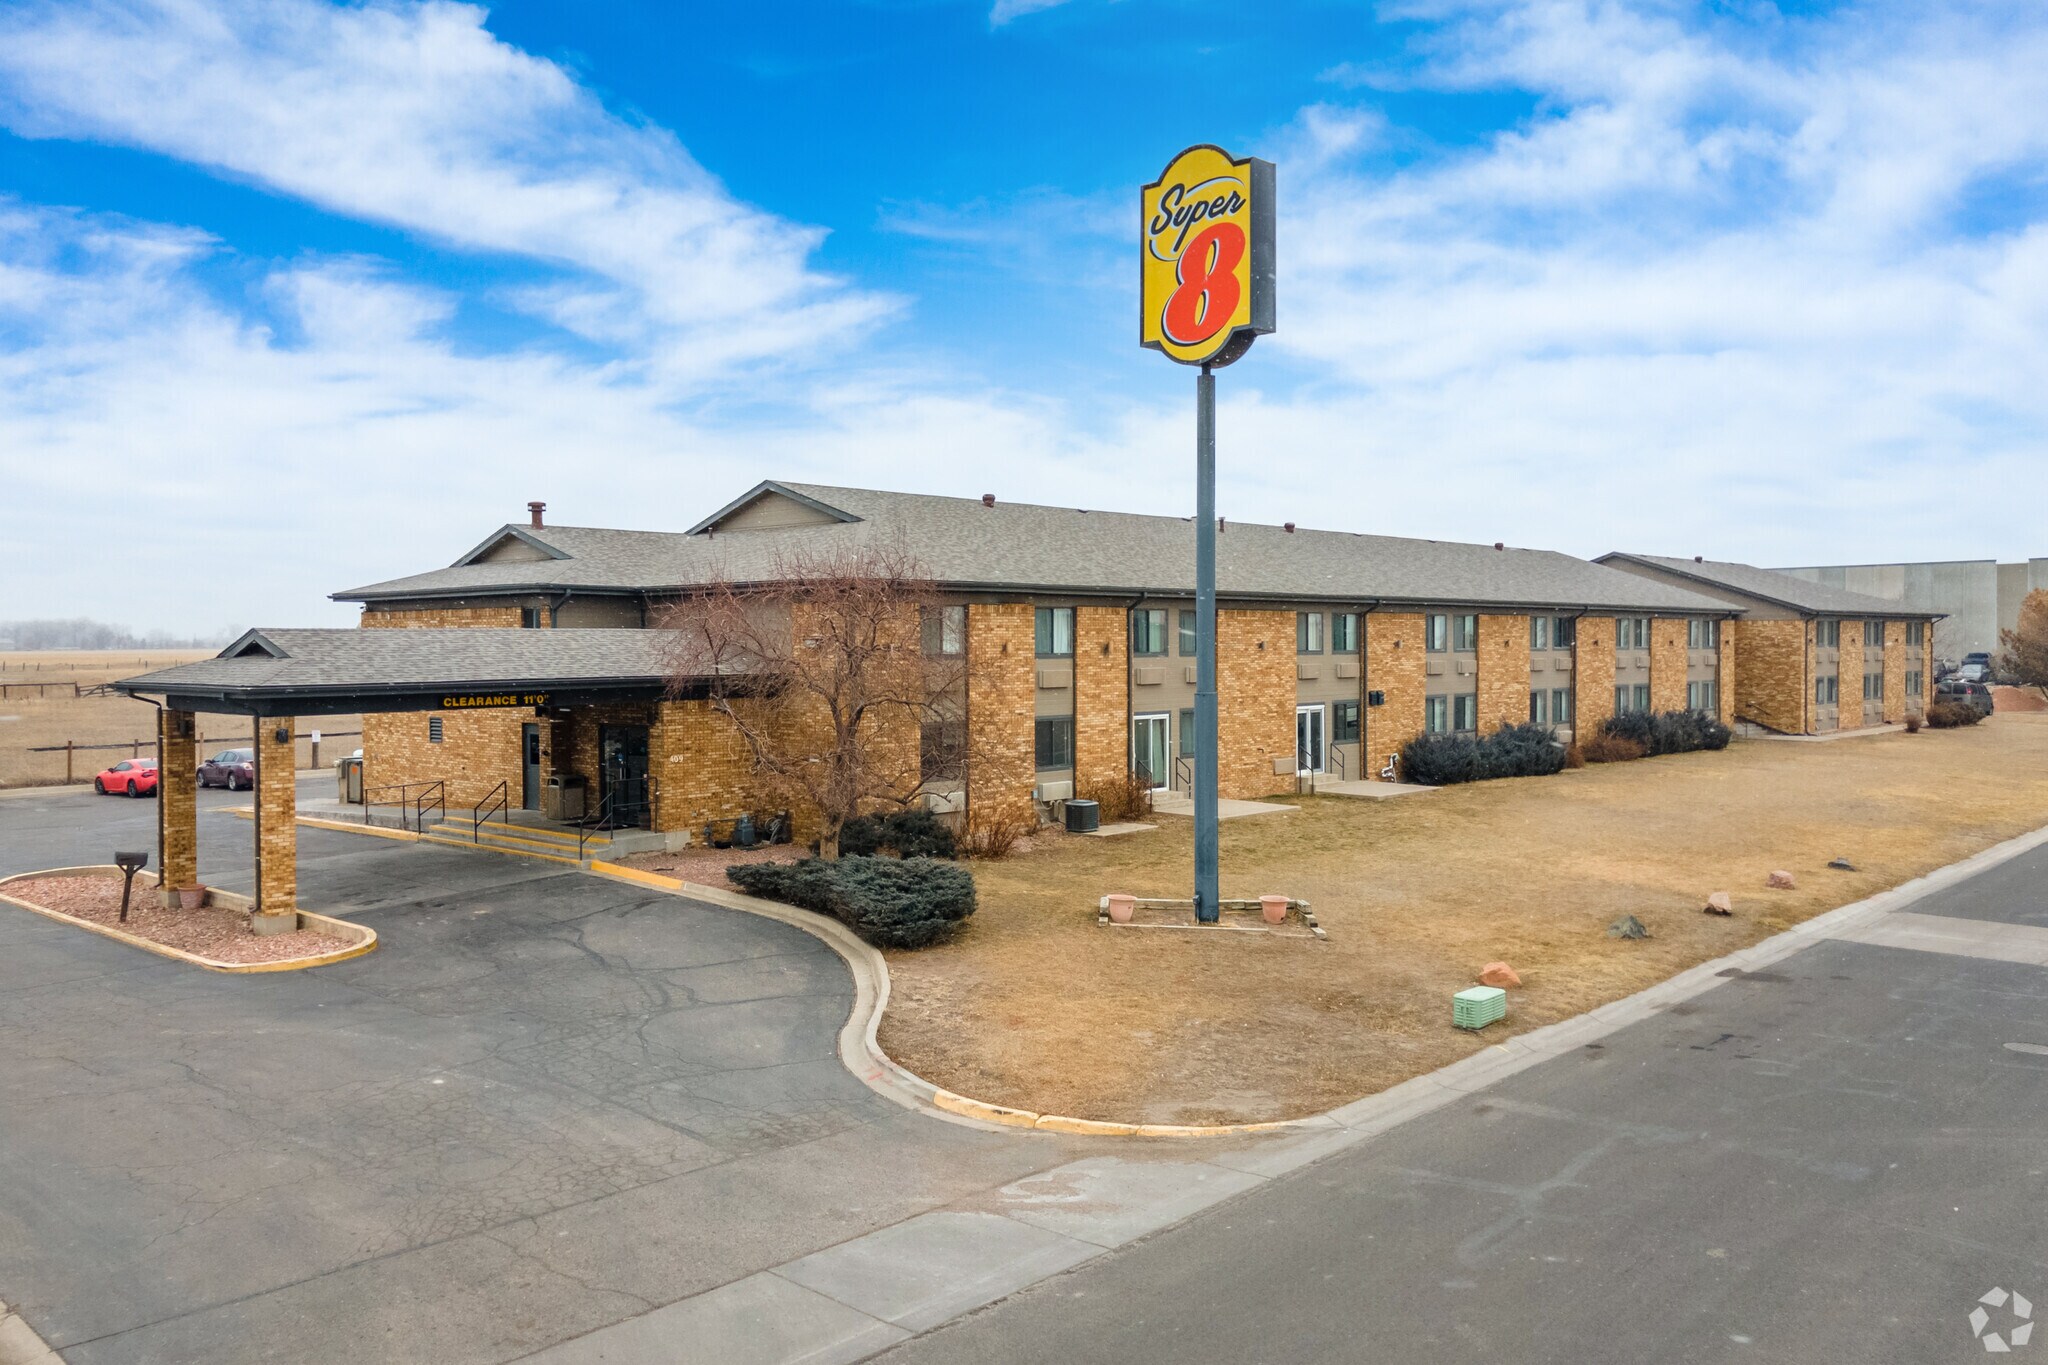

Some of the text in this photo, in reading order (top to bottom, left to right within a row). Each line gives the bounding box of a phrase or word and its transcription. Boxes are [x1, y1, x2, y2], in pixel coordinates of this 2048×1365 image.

[1150, 183, 1246, 254] Super
[1161, 222, 1246, 348] 8
[443, 695, 517, 707] CLEARANCE
[669, 754, 684, 763] 409
